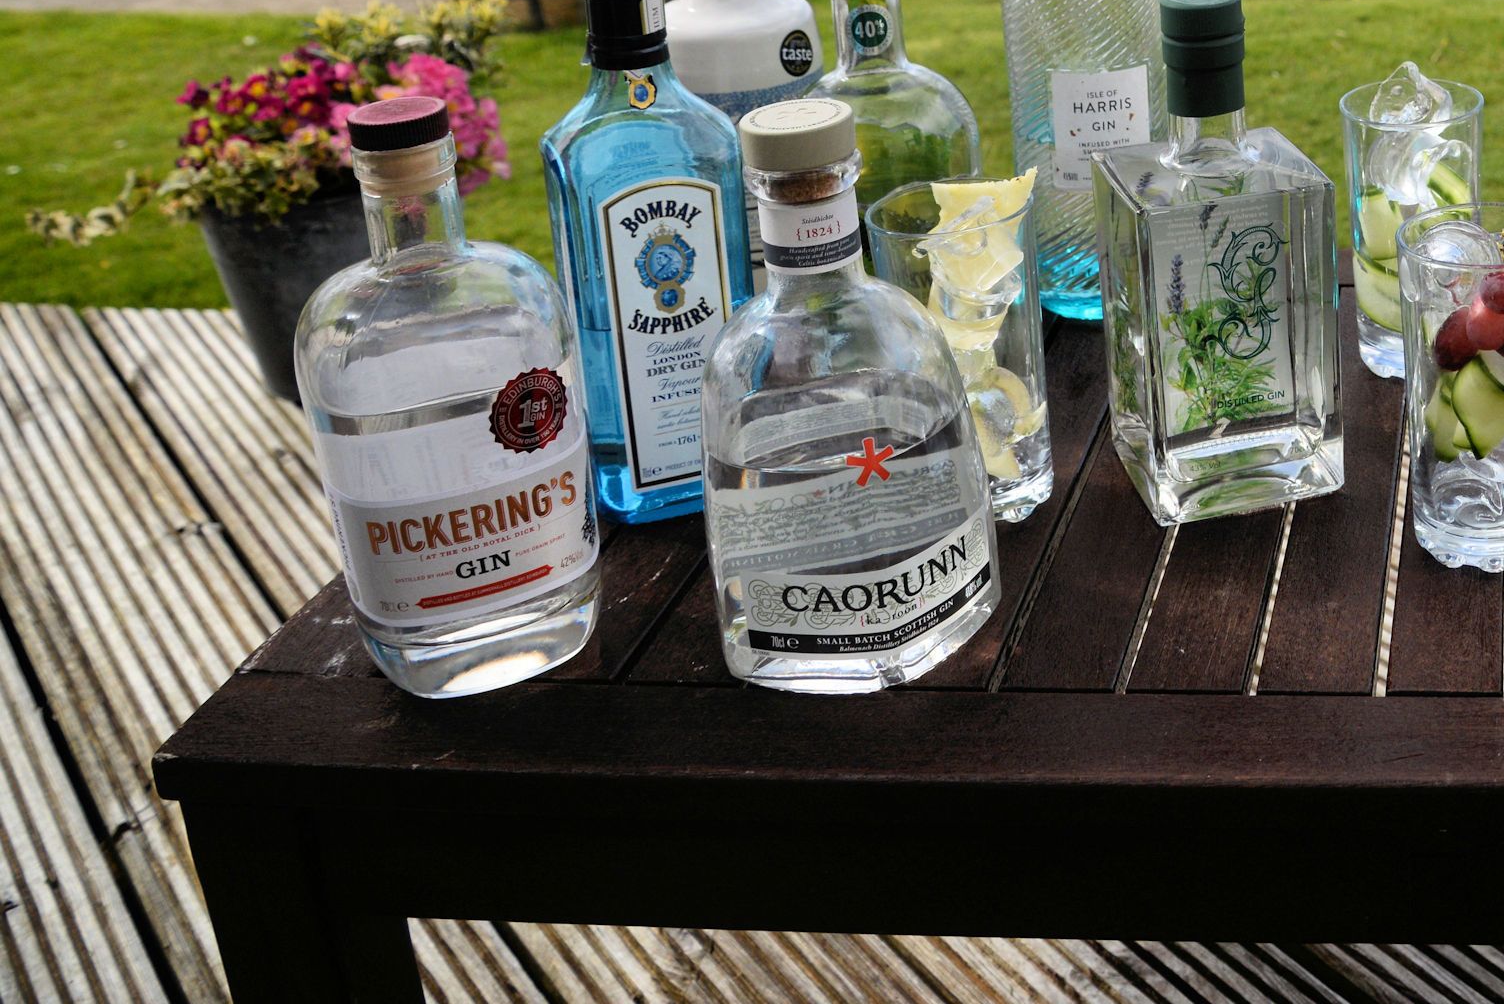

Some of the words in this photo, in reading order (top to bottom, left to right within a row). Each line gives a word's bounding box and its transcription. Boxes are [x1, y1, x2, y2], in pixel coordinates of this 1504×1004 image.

[782, 47, 812, 61] taste
[1106, 89, 1118, 97] OF
[1073, 97, 1132, 114] HARRIS
[1092, 120, 1116, 132] GIN
[1079, 140, 1110, 148] INFUSED
[619, 200, 702, 238] BOMBAY
[627, 296, 715, 335] SAPPHIRE
[646, 334, 706, 358] Distilled
[646, 363, 677, 377] DRY
[681, 358, 706, 371] GIN
[653, 351, 702, 366] LONDON
[503, 377, 561, 405] EDINBURGH'S
[651, 387, 701, 403] INFUSE
[1217, 394, 1264, 409] DISTILLED
[1267, 390, 1285, 401] GIN
[517, 396, 548, 428] 1st
[531, 411, 545, 421] GIN
[677, 434, 697, 446] 1761
[366, 470, 577, 556] PICKERING'S
[426, 553, 436, 561] AT
[440, 549, 458, 557] THE
[461, 543, 480, 553] OLD
[483, 535, 512, 548] ROYAL
[515, 527, 535, 538] DICK
[455, 550, 512, 579] GIN
[782, 535, 967, 613] CAORUNN
[816, 636, 852, 646] SMALL
[855, 633, 891, 645] BATCH
[894, 610, 938, 638] SCOTTISH
[940, 598, 954, 613] GIN
